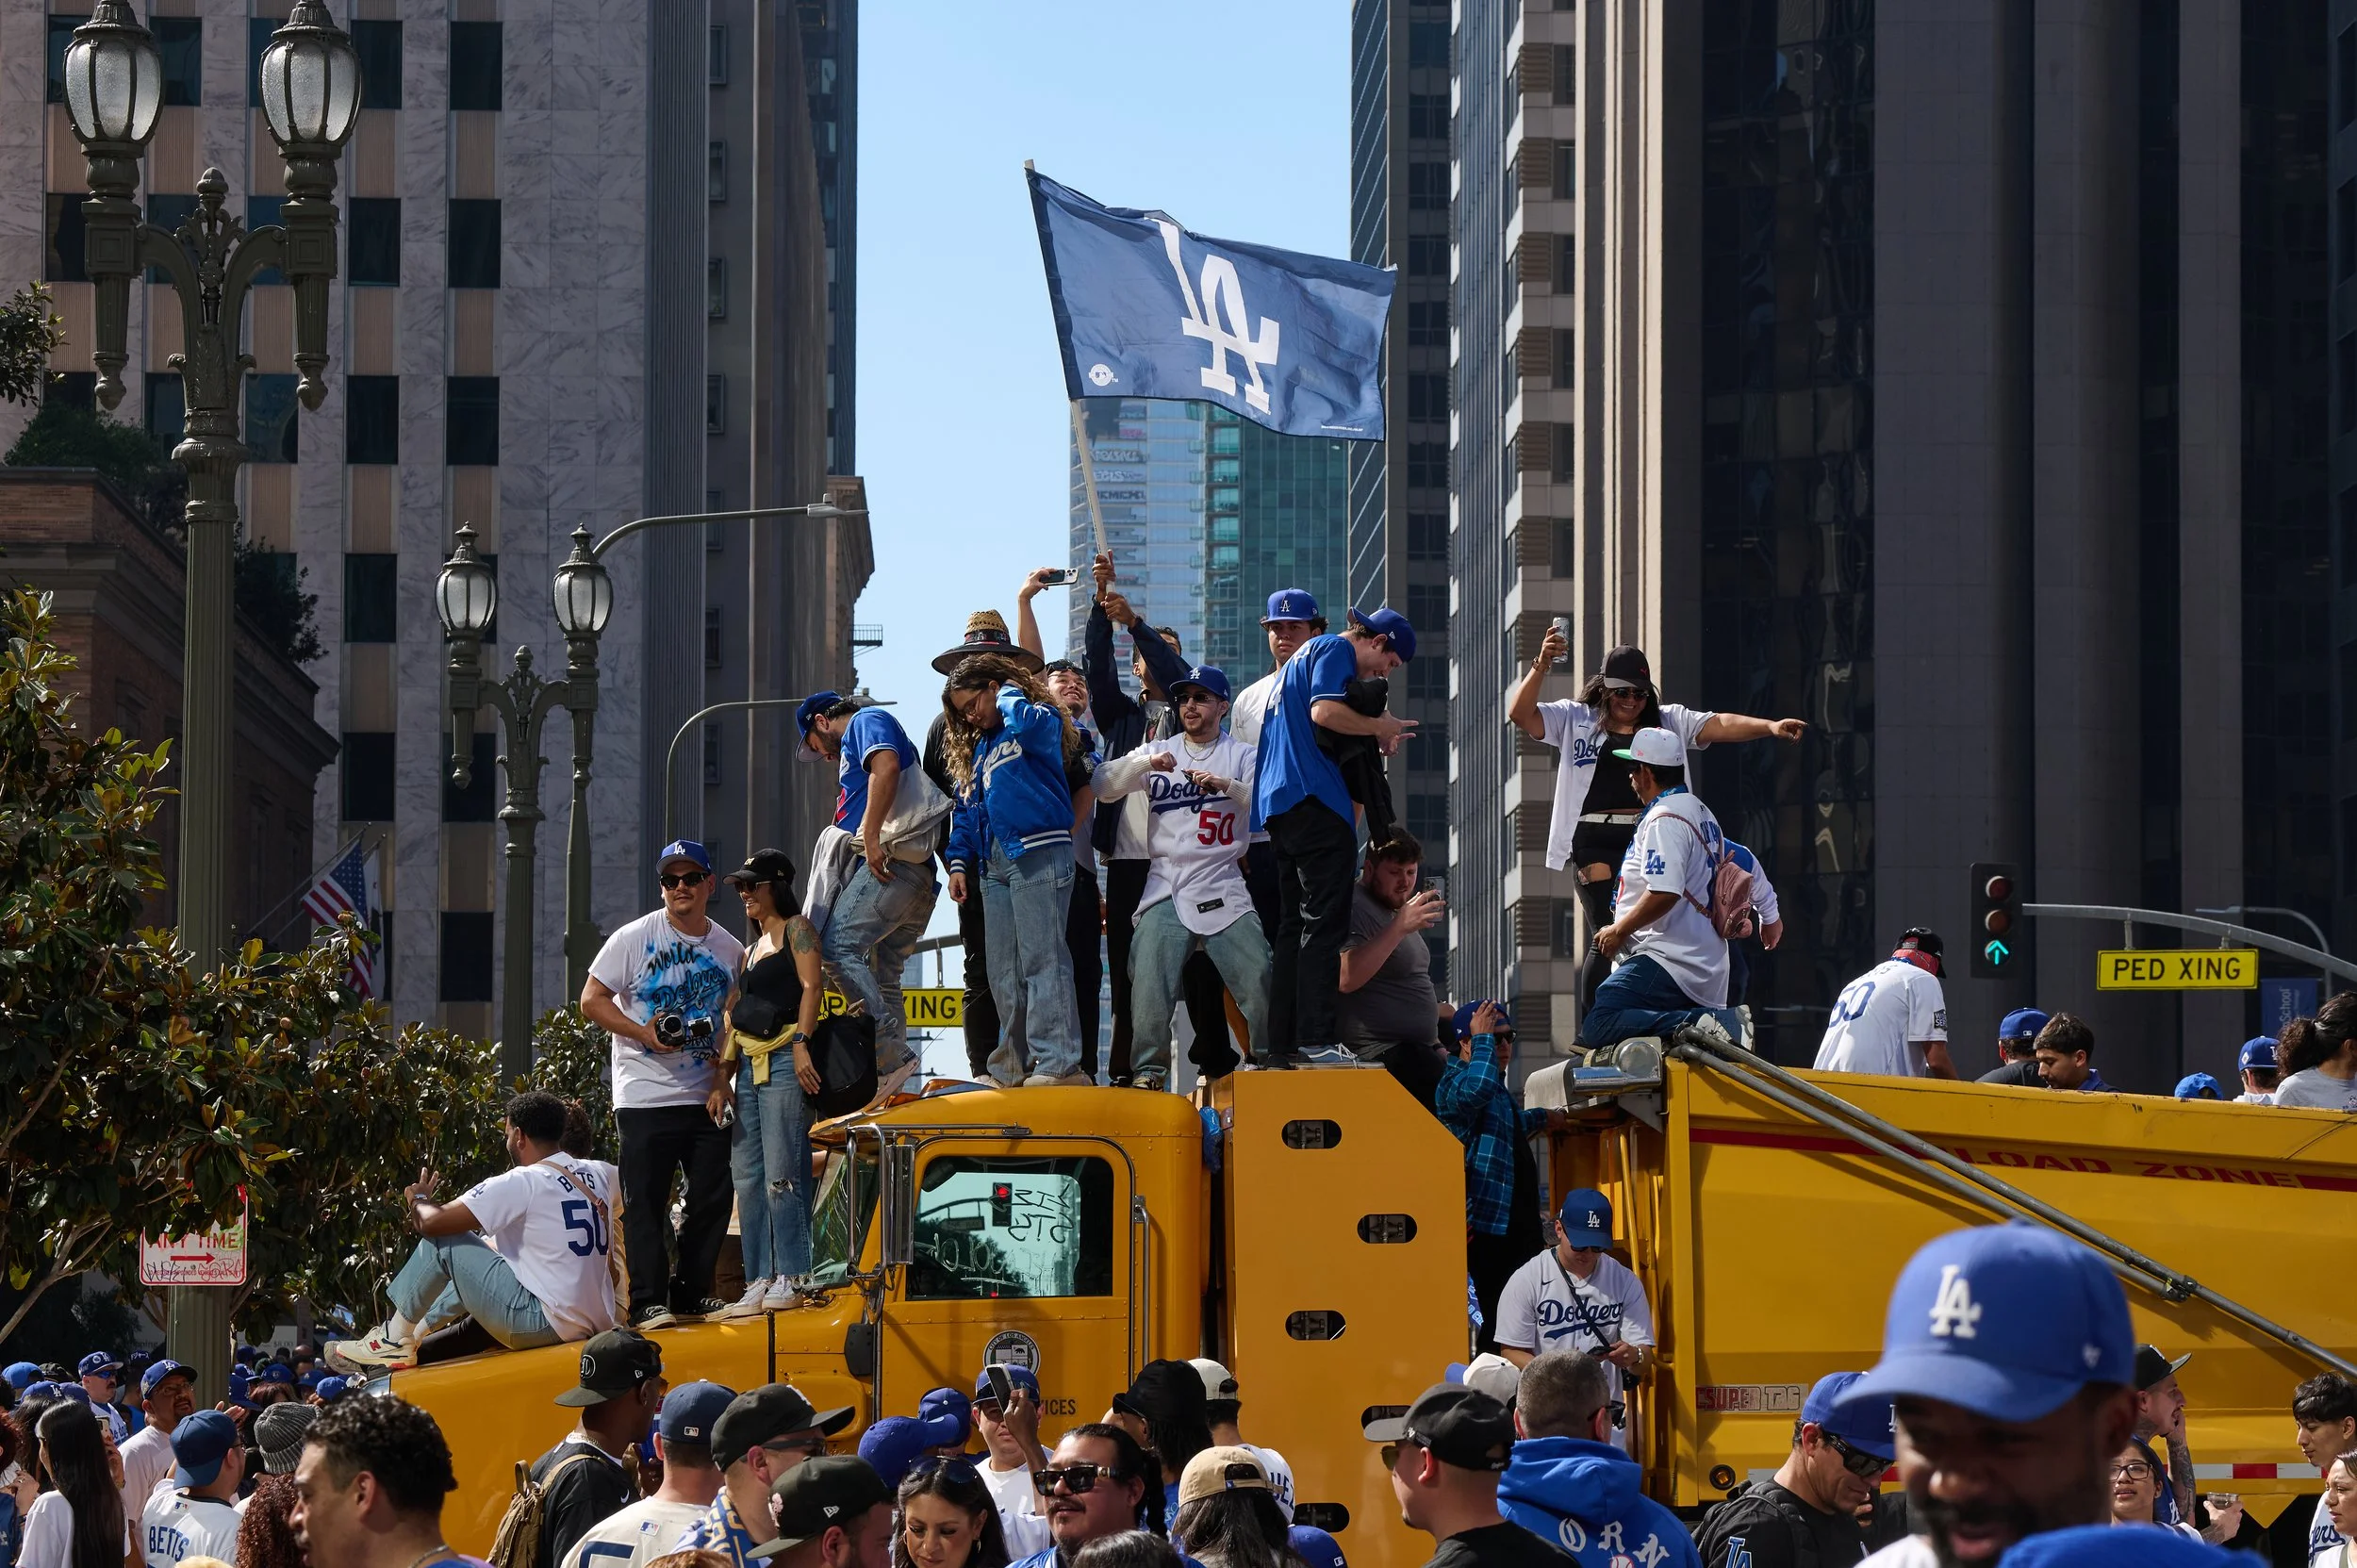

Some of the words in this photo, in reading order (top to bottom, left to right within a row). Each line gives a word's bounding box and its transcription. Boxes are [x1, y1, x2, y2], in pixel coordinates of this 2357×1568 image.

[1144, 217, 1280, 416] LA
[1197, 809, 1236, 846] 50
[673, 842, 686, 855] LA
[1645, 849, 1666, 875] LA
[2114, 958, 2165, 981] PED
[2179, 957, 2241, 981] XING
[1954, 1147, 2113, 1175] LOAD
[2133, 1161, 2298, 1188] ZONE
[557, 1172, 596, 1193] BTS
[561, 1199, 609, 1257] 50
[1587, 1210, 1600, 1228] LA
[198, 1232, 239, 1248] TIME
[1928, 1264, 1982, 1339] LA
[1016, 1334, 1034, 1350] ANGELES
[50, 1384, 63, 1397] LA
[1764, 1385, 1801, 1411] TAG
[1041, 1399, 1076, 1414] ICES
[149, 1526, 190, 1562] BETTS
